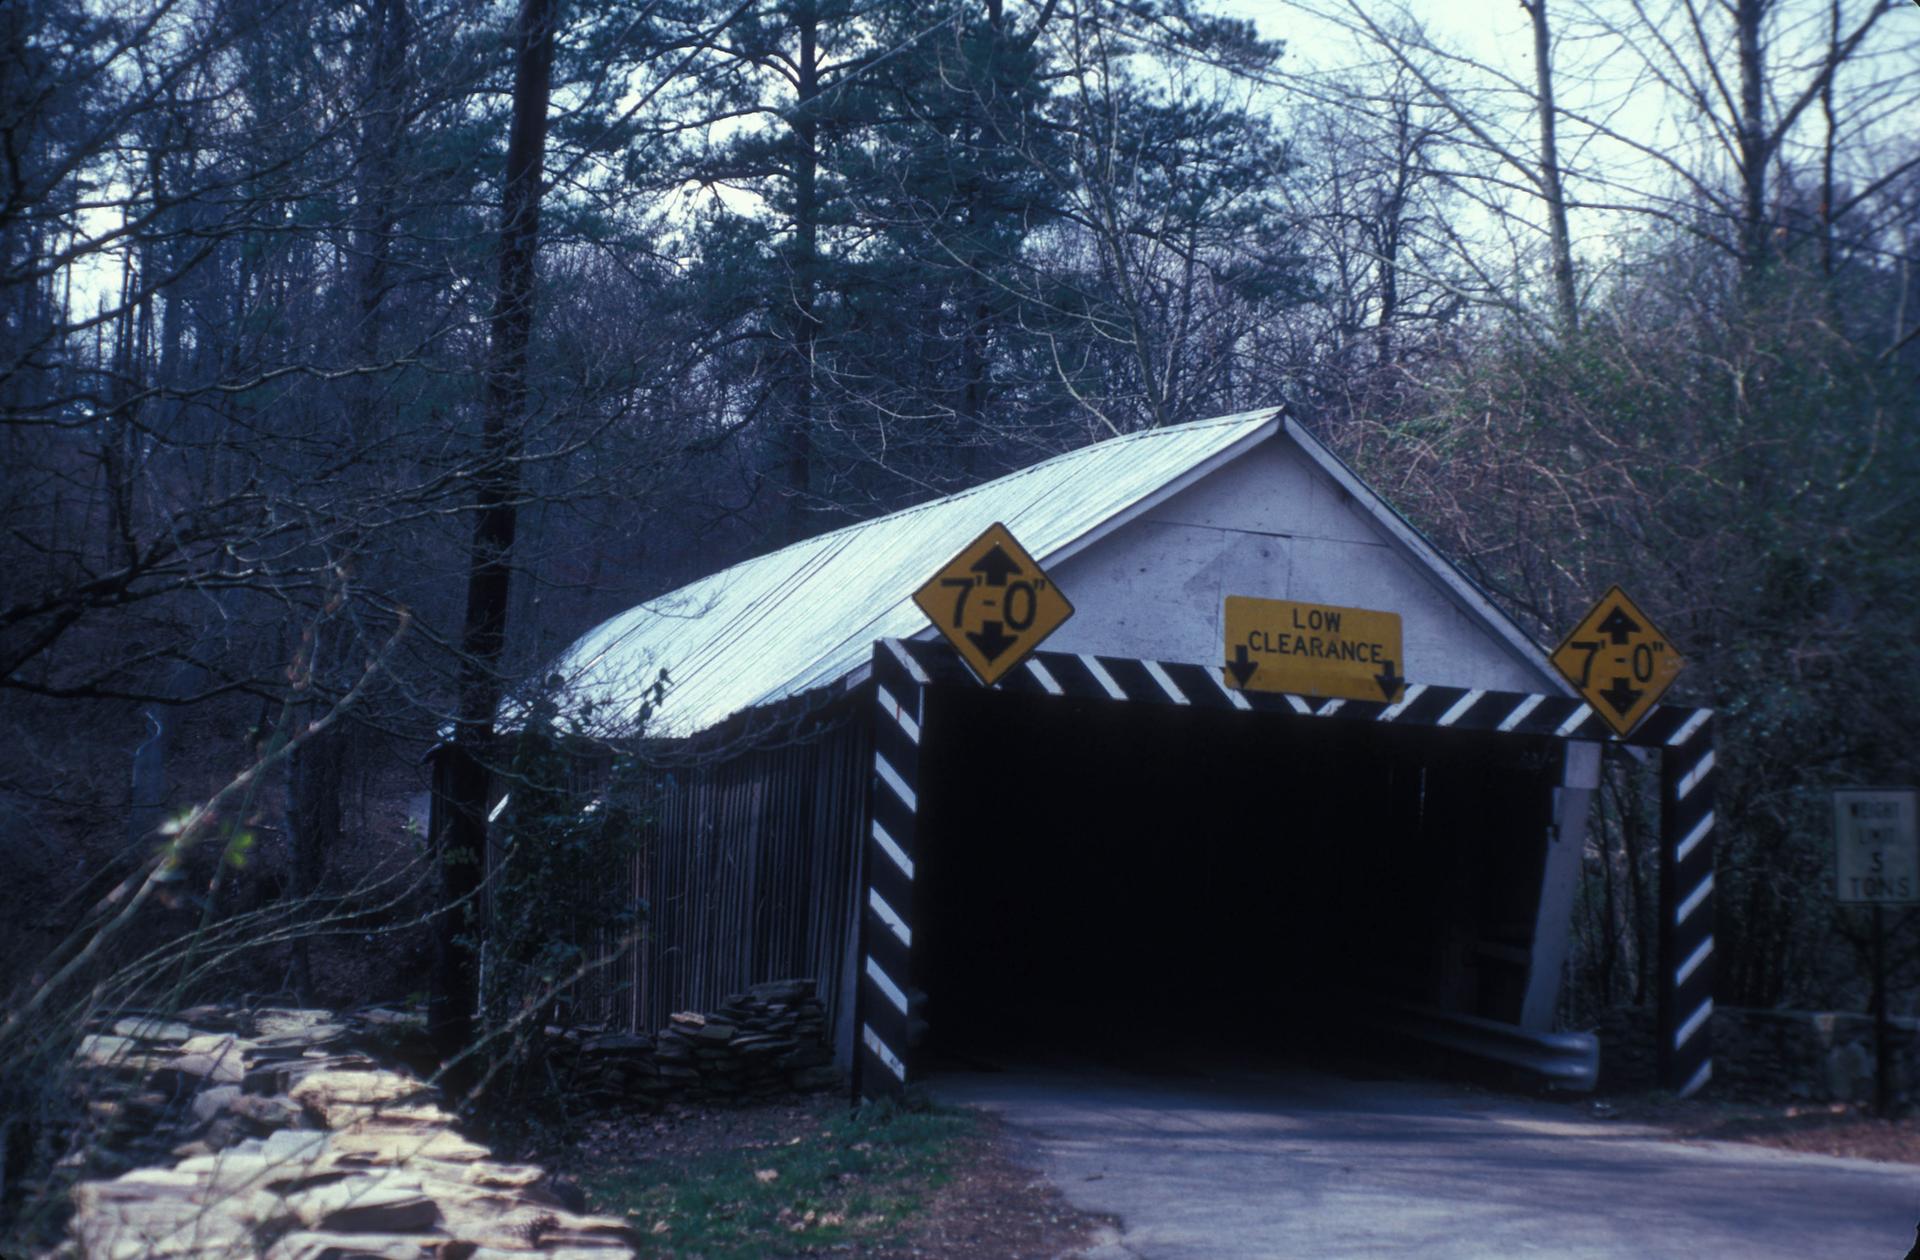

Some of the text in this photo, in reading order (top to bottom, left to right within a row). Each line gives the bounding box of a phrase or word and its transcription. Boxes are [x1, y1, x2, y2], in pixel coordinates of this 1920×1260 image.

[1293, 608, 1341, 632] LOW
[1248, 630, 1384, 664] CLEARANCE
[1849, 877, 1910, 897] TONS
